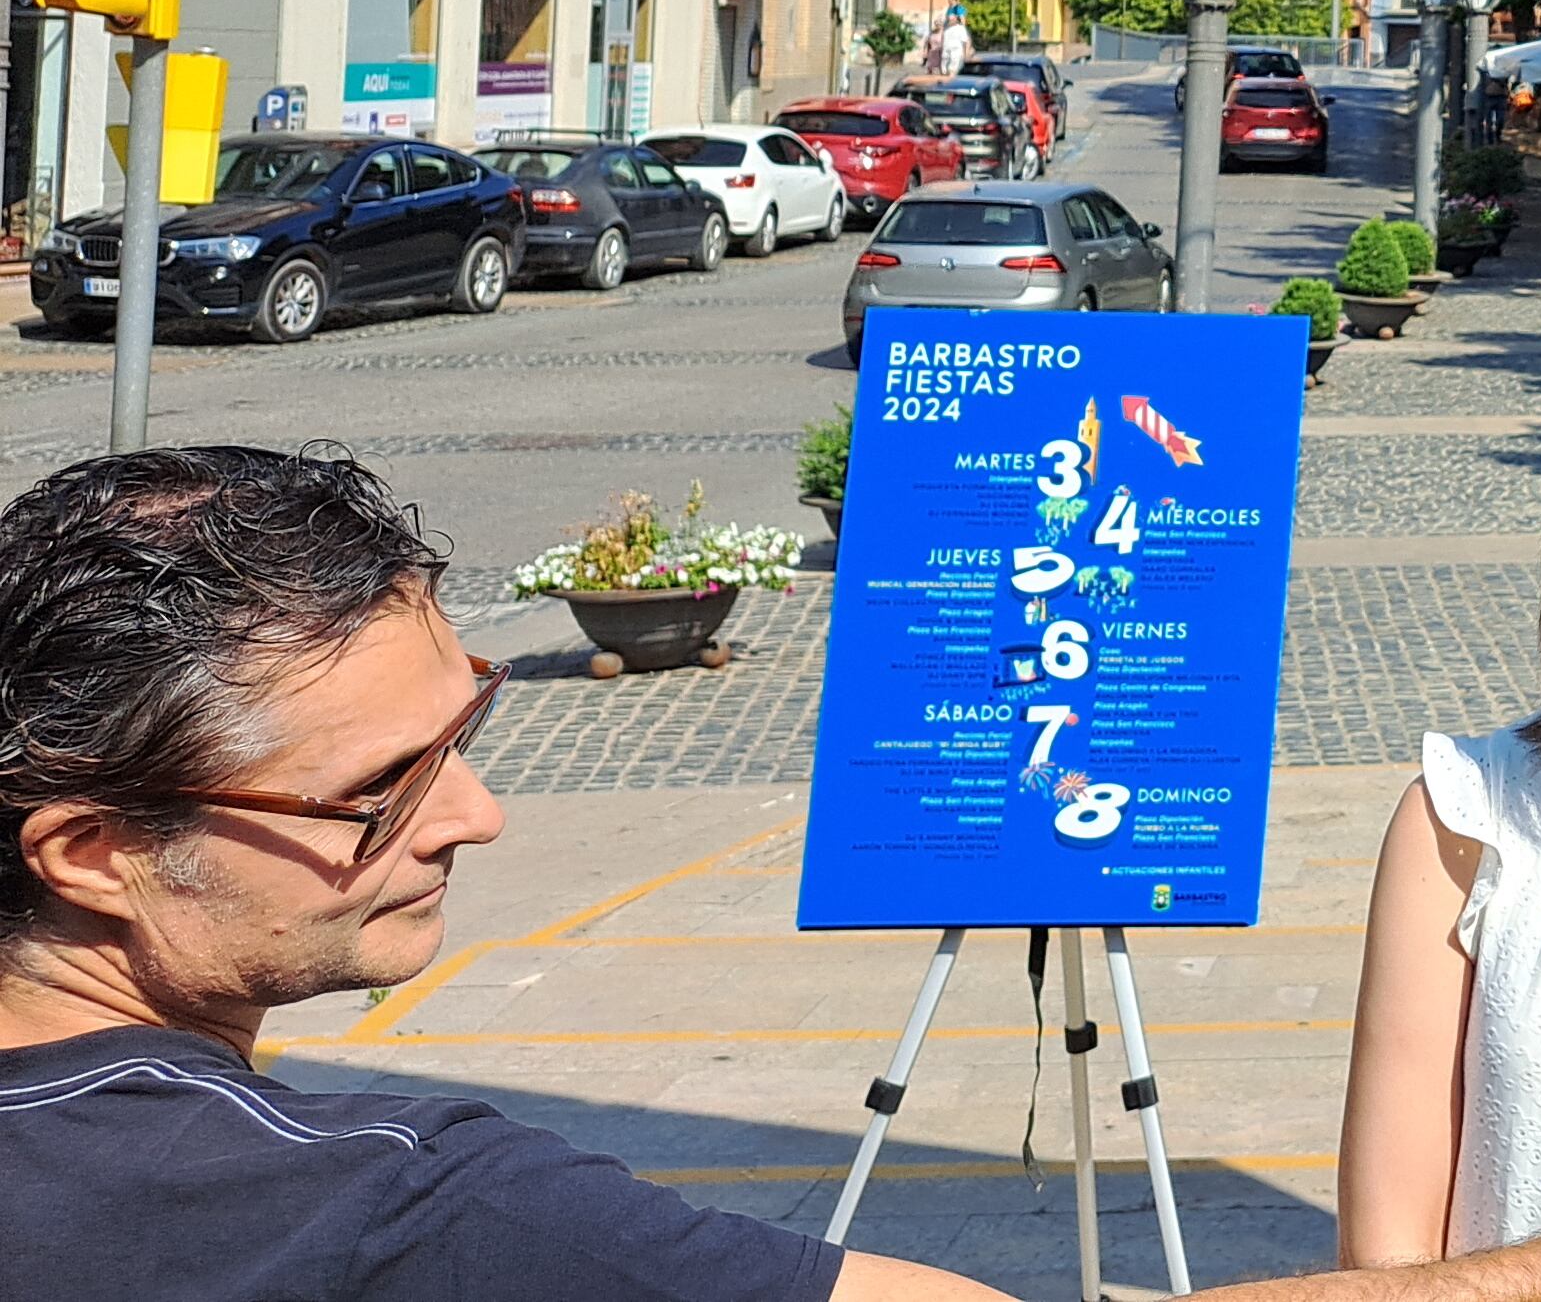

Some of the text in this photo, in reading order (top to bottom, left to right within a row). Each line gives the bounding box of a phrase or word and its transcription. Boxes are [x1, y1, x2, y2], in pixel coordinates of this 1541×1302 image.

[266, 94, 284, 116] P
[889, 341, 1080, 369] BARBASTRO
[886, 369, 1015, 395] FIESTAS
[882, 396, 961, 422] 2024
[954, 452, 1036, 471] MARTES
[1037, 439, 1083, 499] 3
[1095, 495, 1140, 554] 4
[1146, 503, 1261, 526] MIÉRCOLES
[925, 548, 1003, 567] JUEVES
[1011, 546, 1075, 593] 5
[867, 580, 904, 588] MUSICAL
[1101, 621, 1188, 640] VIERNES
[1041, 619, 1089, 680] 6
[1135, 655, 1148, 664] DE
[924, 699, 1013, 722] SÁBADO
[1026, 705, 1071, 768] 7
[1136, 787, 1232, 804] DOMINGO
[1055, 783, 1130, 838] 8
[1133, 824, 1166, 832] RUMBO
[1111, 865, 1227, 876] ACTUACIONES INFANTILES
